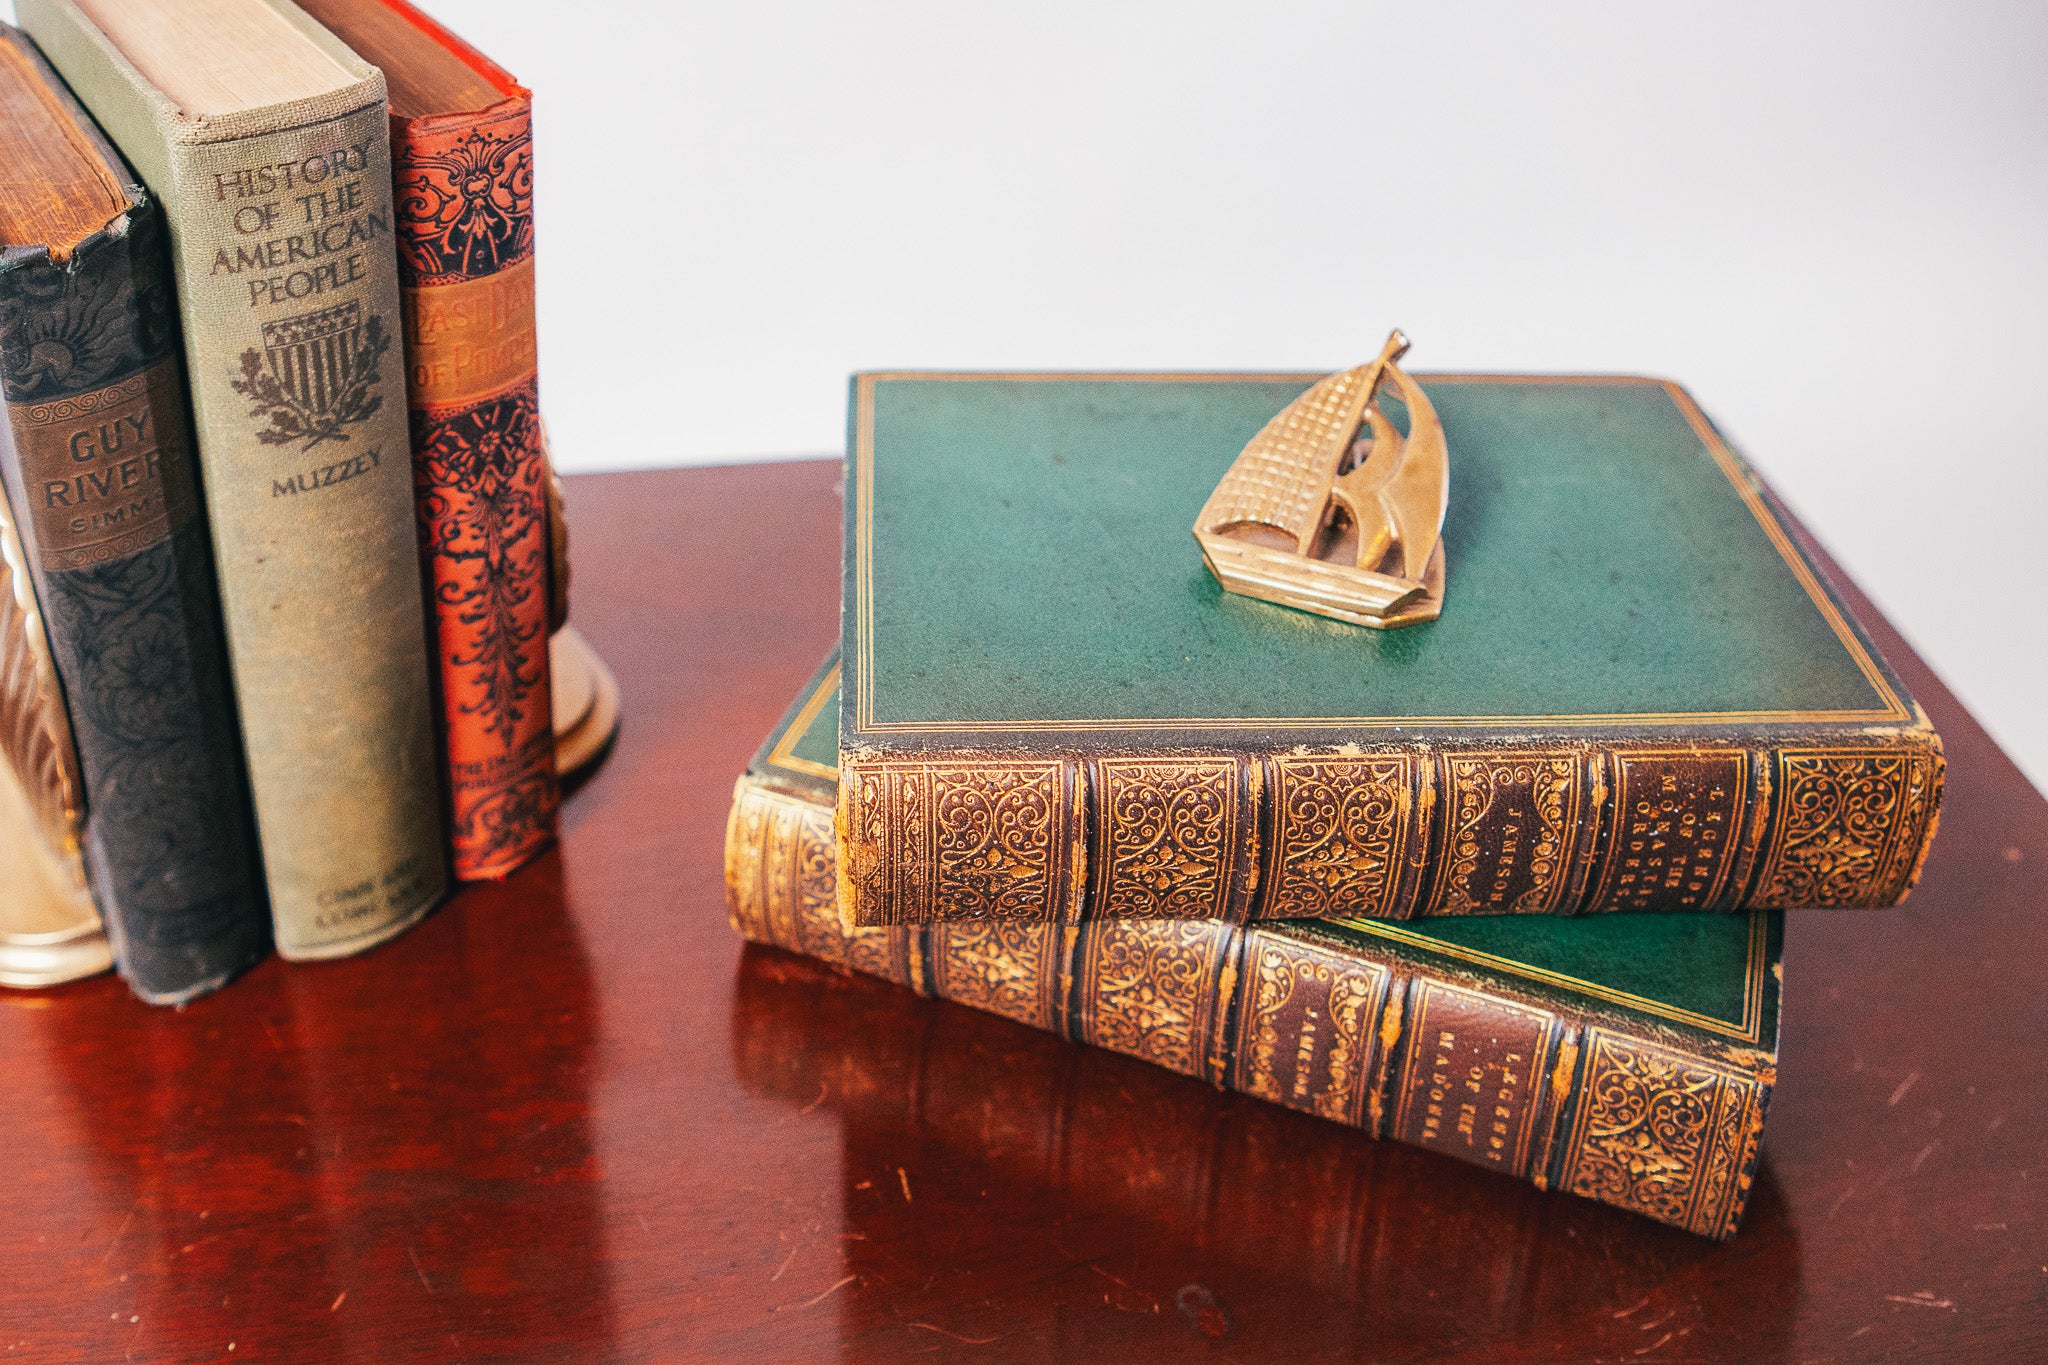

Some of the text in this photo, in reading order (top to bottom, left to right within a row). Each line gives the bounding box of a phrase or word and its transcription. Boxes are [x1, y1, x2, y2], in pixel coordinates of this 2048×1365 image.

[214, 141, 371, 201] HISTORY
[210, 204, 391, 276] AMERICAN
[234, 181, 364, 235] OF THE
[248, 253, 365, 307] PEOPLE
[69, 410, 150, 463] GUY
[272, 445, 382, 497] MUZZEY
[1634, 774, 1676, 906] MONASTIC
[1665, 812, 1697, 887] OF THE
[1682, 789, 1725, 904] LEGENDS
[1457, 1066, 1484, 1135] OF THE
